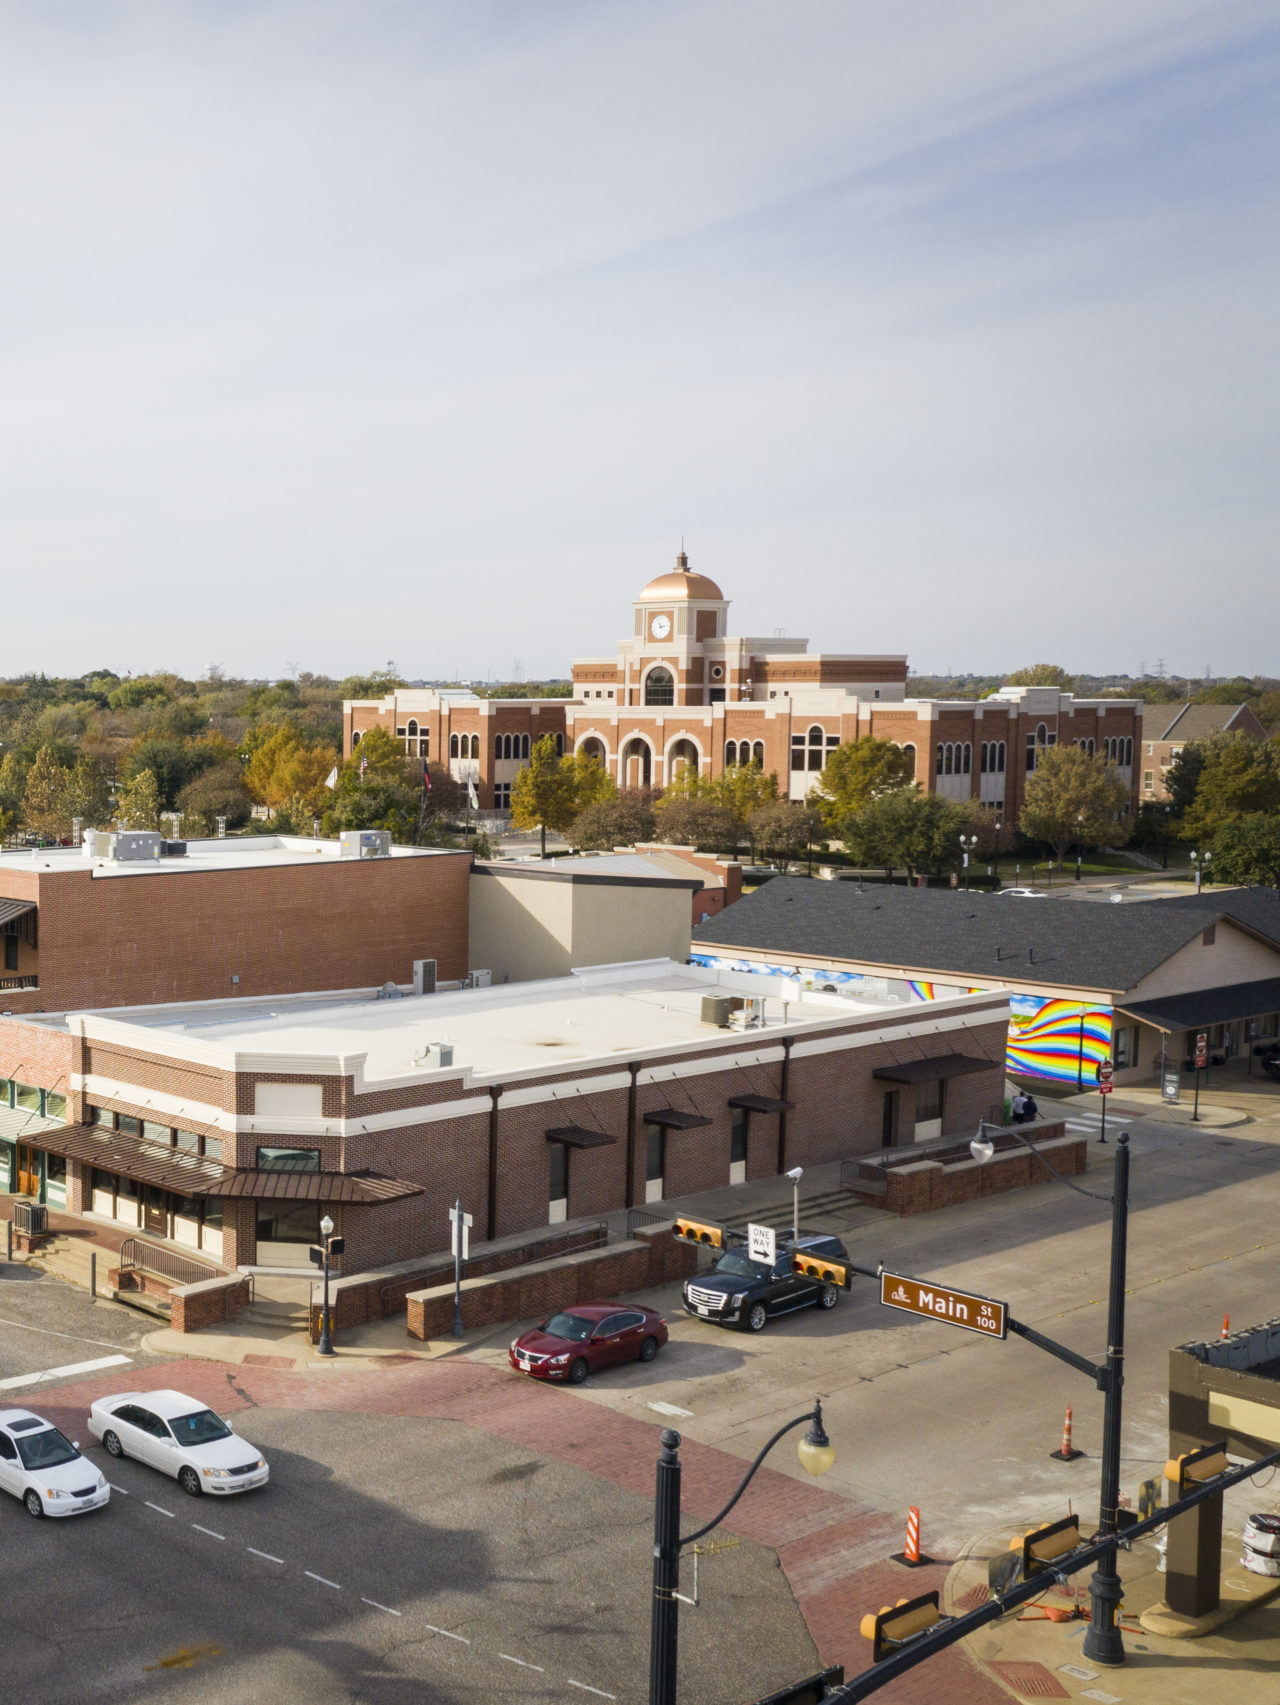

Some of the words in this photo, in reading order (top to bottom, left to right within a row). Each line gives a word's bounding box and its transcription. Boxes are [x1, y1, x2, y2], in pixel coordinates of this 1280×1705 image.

[753, 1228, 770, 1239] ONE
[753, 1237, 770, 1248] WAY
[919, 1289, 968, 1320] Main
[981, 1305, 992, 1317] St
[976, 1316, 996, 1329] 100
